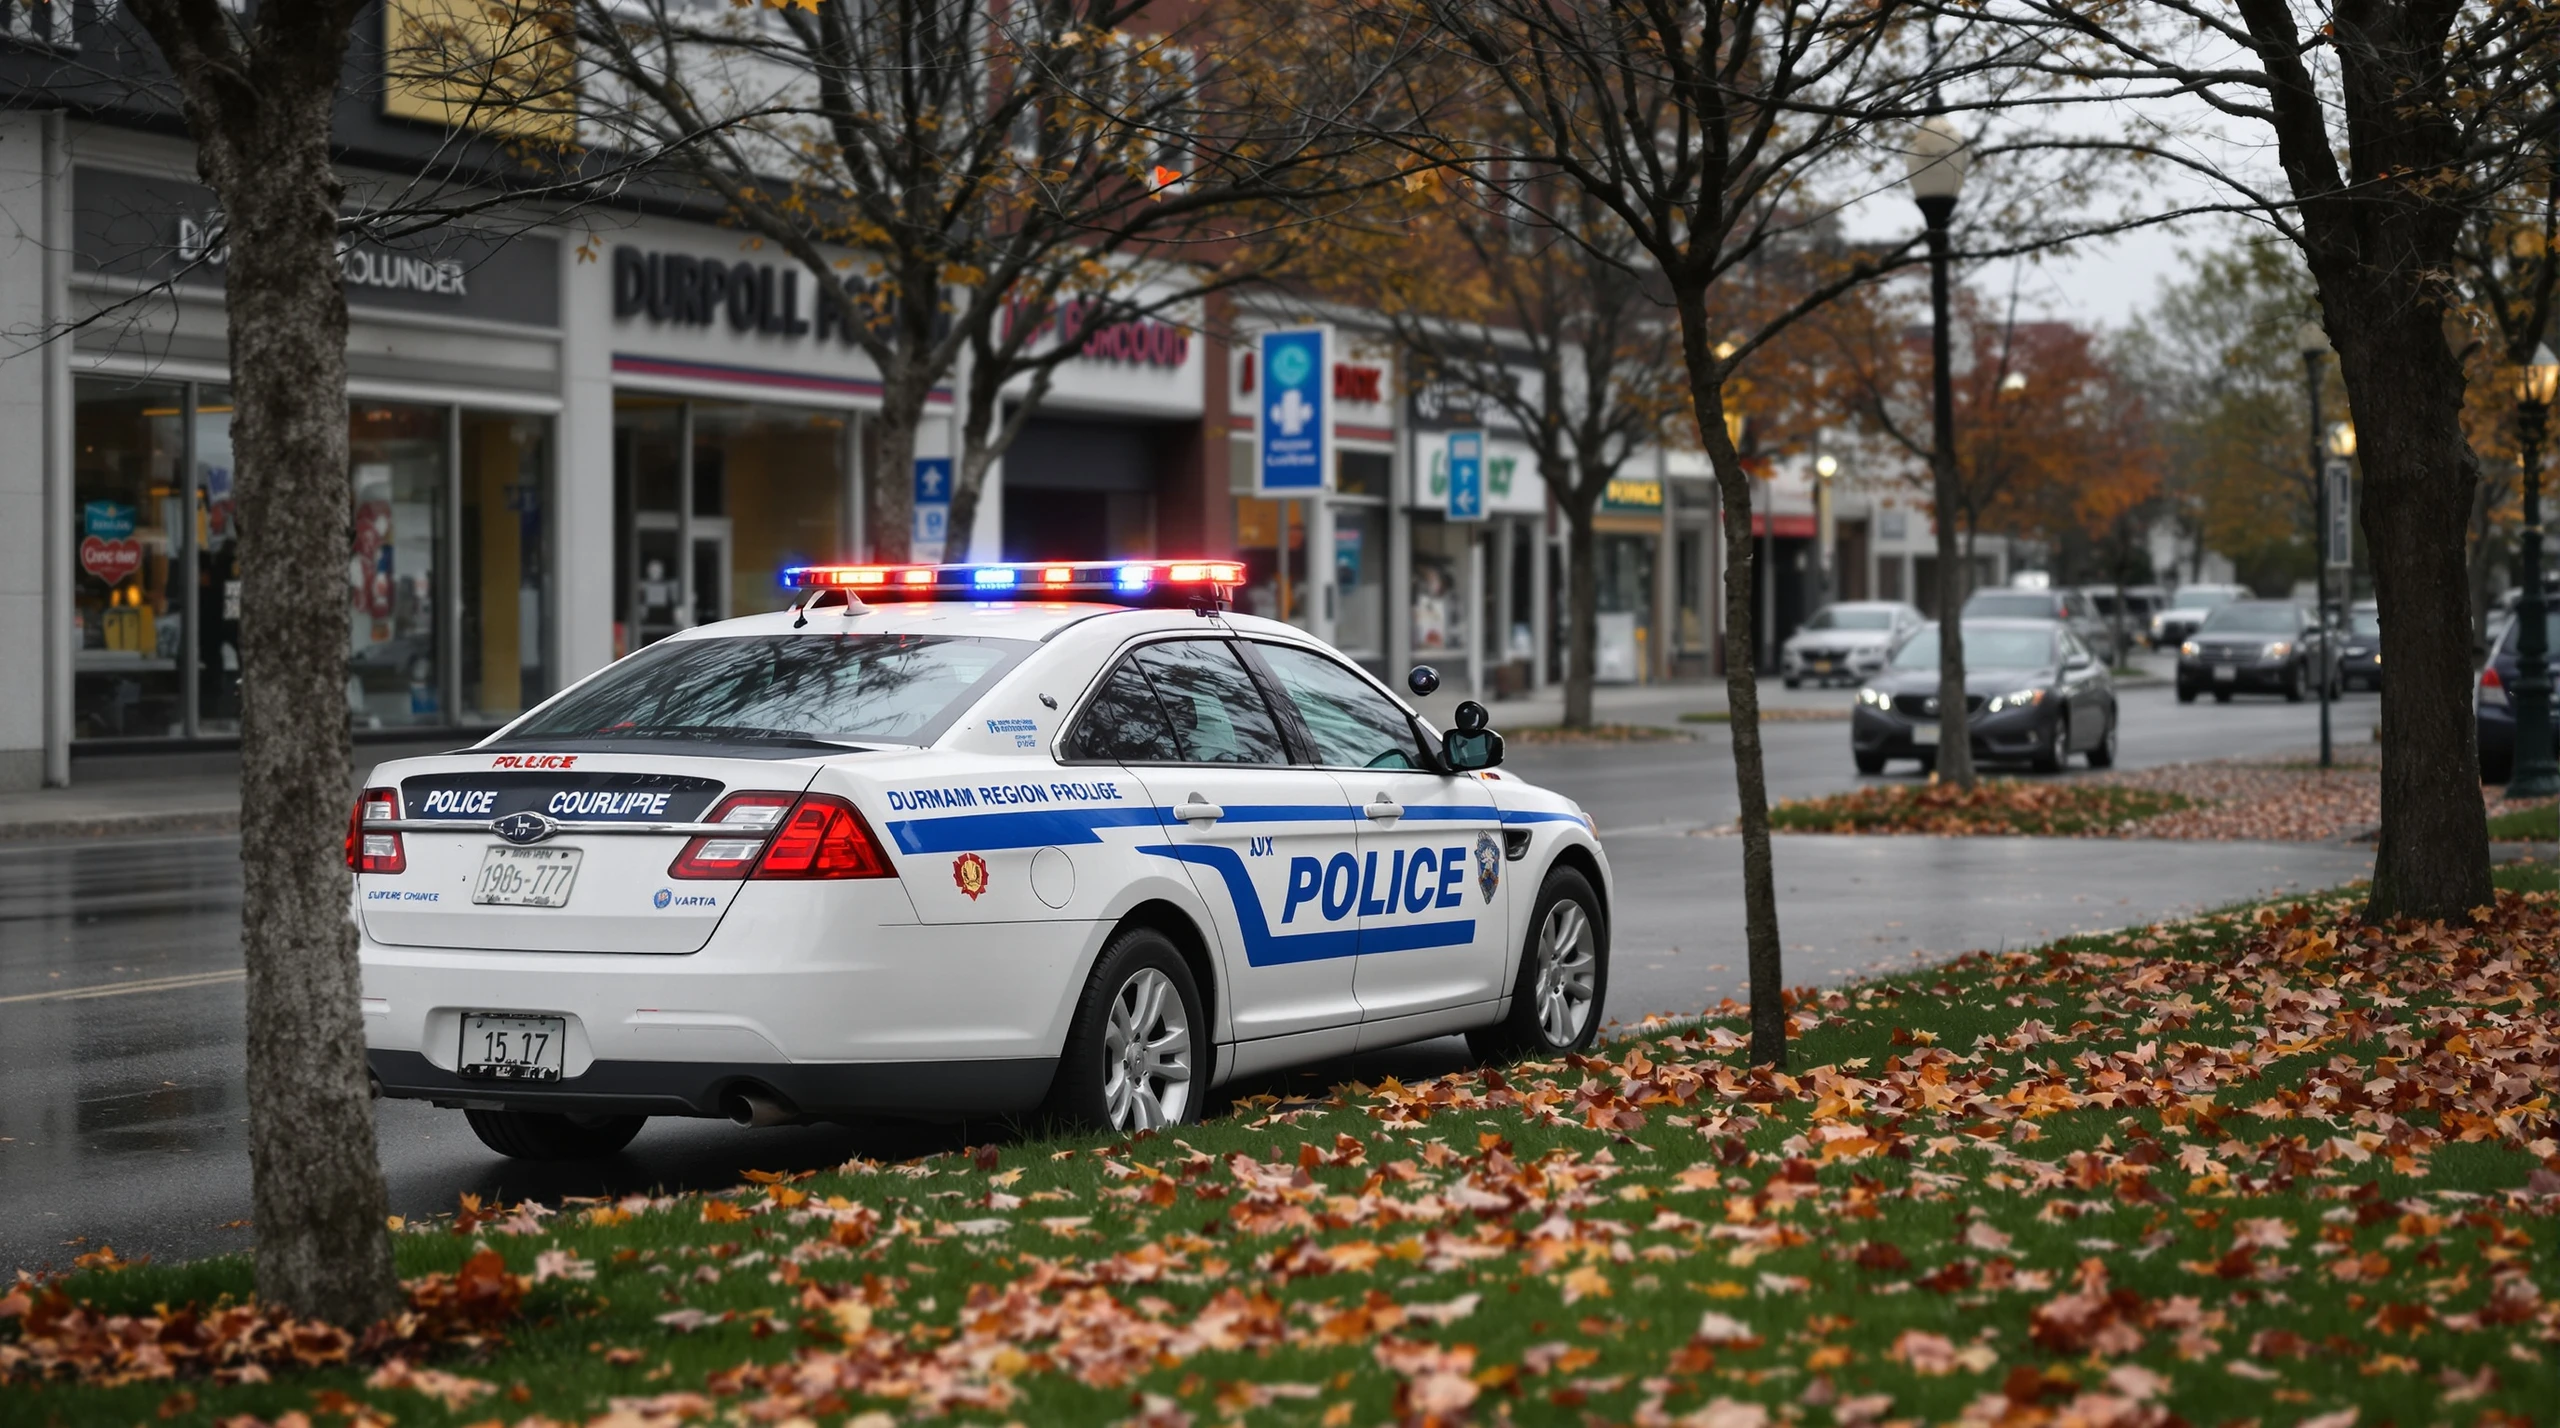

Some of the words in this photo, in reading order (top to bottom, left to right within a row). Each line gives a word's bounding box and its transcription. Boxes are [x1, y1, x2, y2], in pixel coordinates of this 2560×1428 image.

[423, 789, 498, 814] POLICE
[978, 784, 1049, 806] REGION
[1281, 847, 1467, 924] POLICE
[483, 1031, 508, 1063] 15
[520, 1032, 549, 1066] 17
